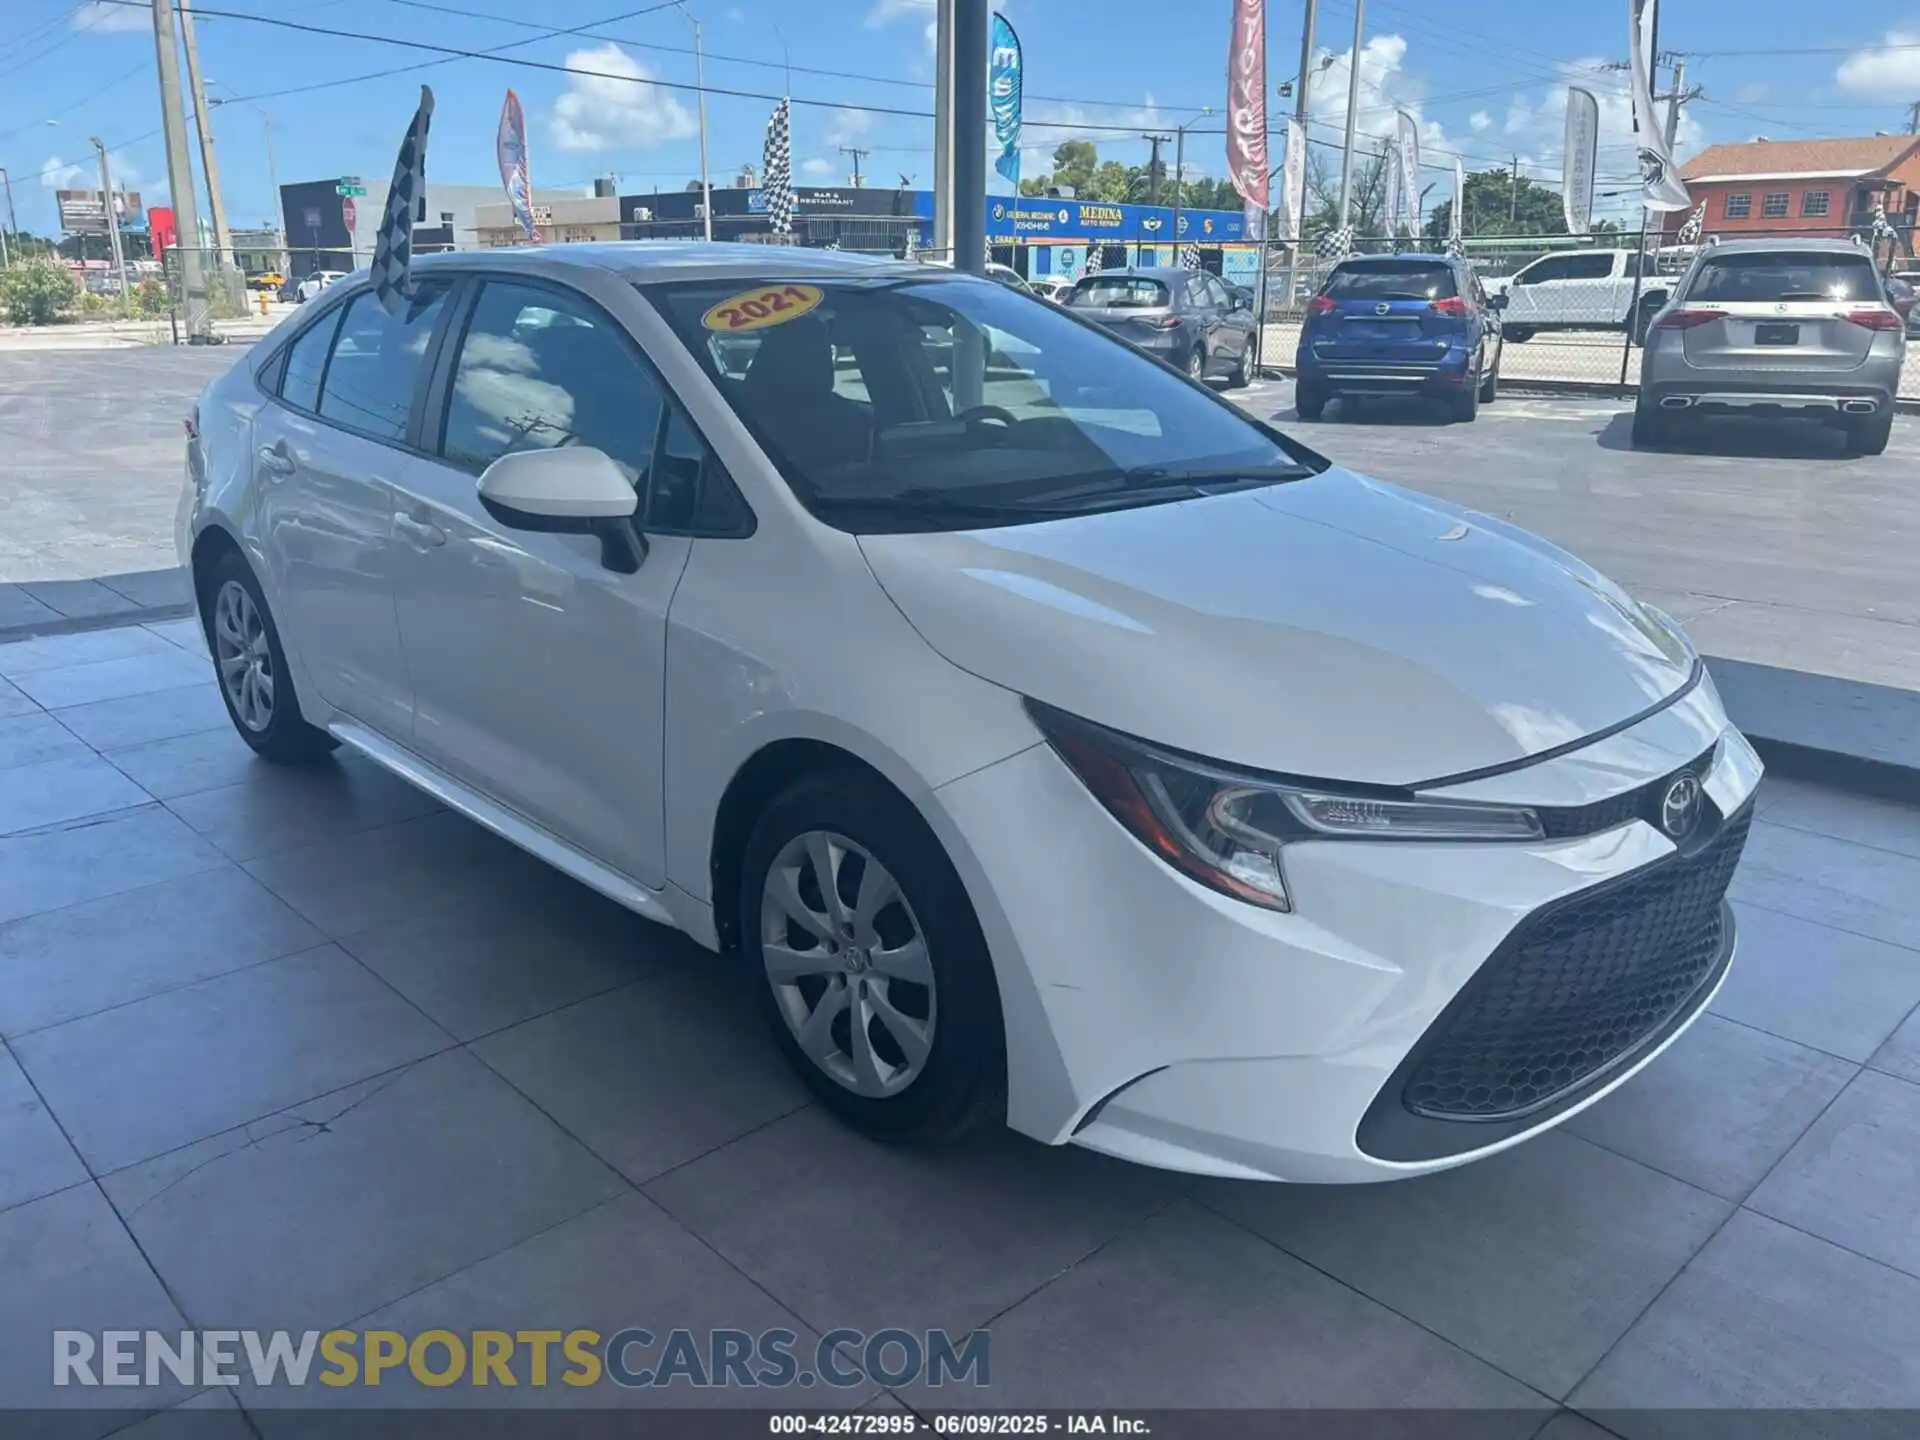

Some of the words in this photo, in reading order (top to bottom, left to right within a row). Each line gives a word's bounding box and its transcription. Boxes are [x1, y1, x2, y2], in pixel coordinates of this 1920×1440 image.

[800, 198, 854, 206] RESTAURANT
[1079, 205, 1122, 220] MEDINA
[717, 287, 811, 328] 2021
